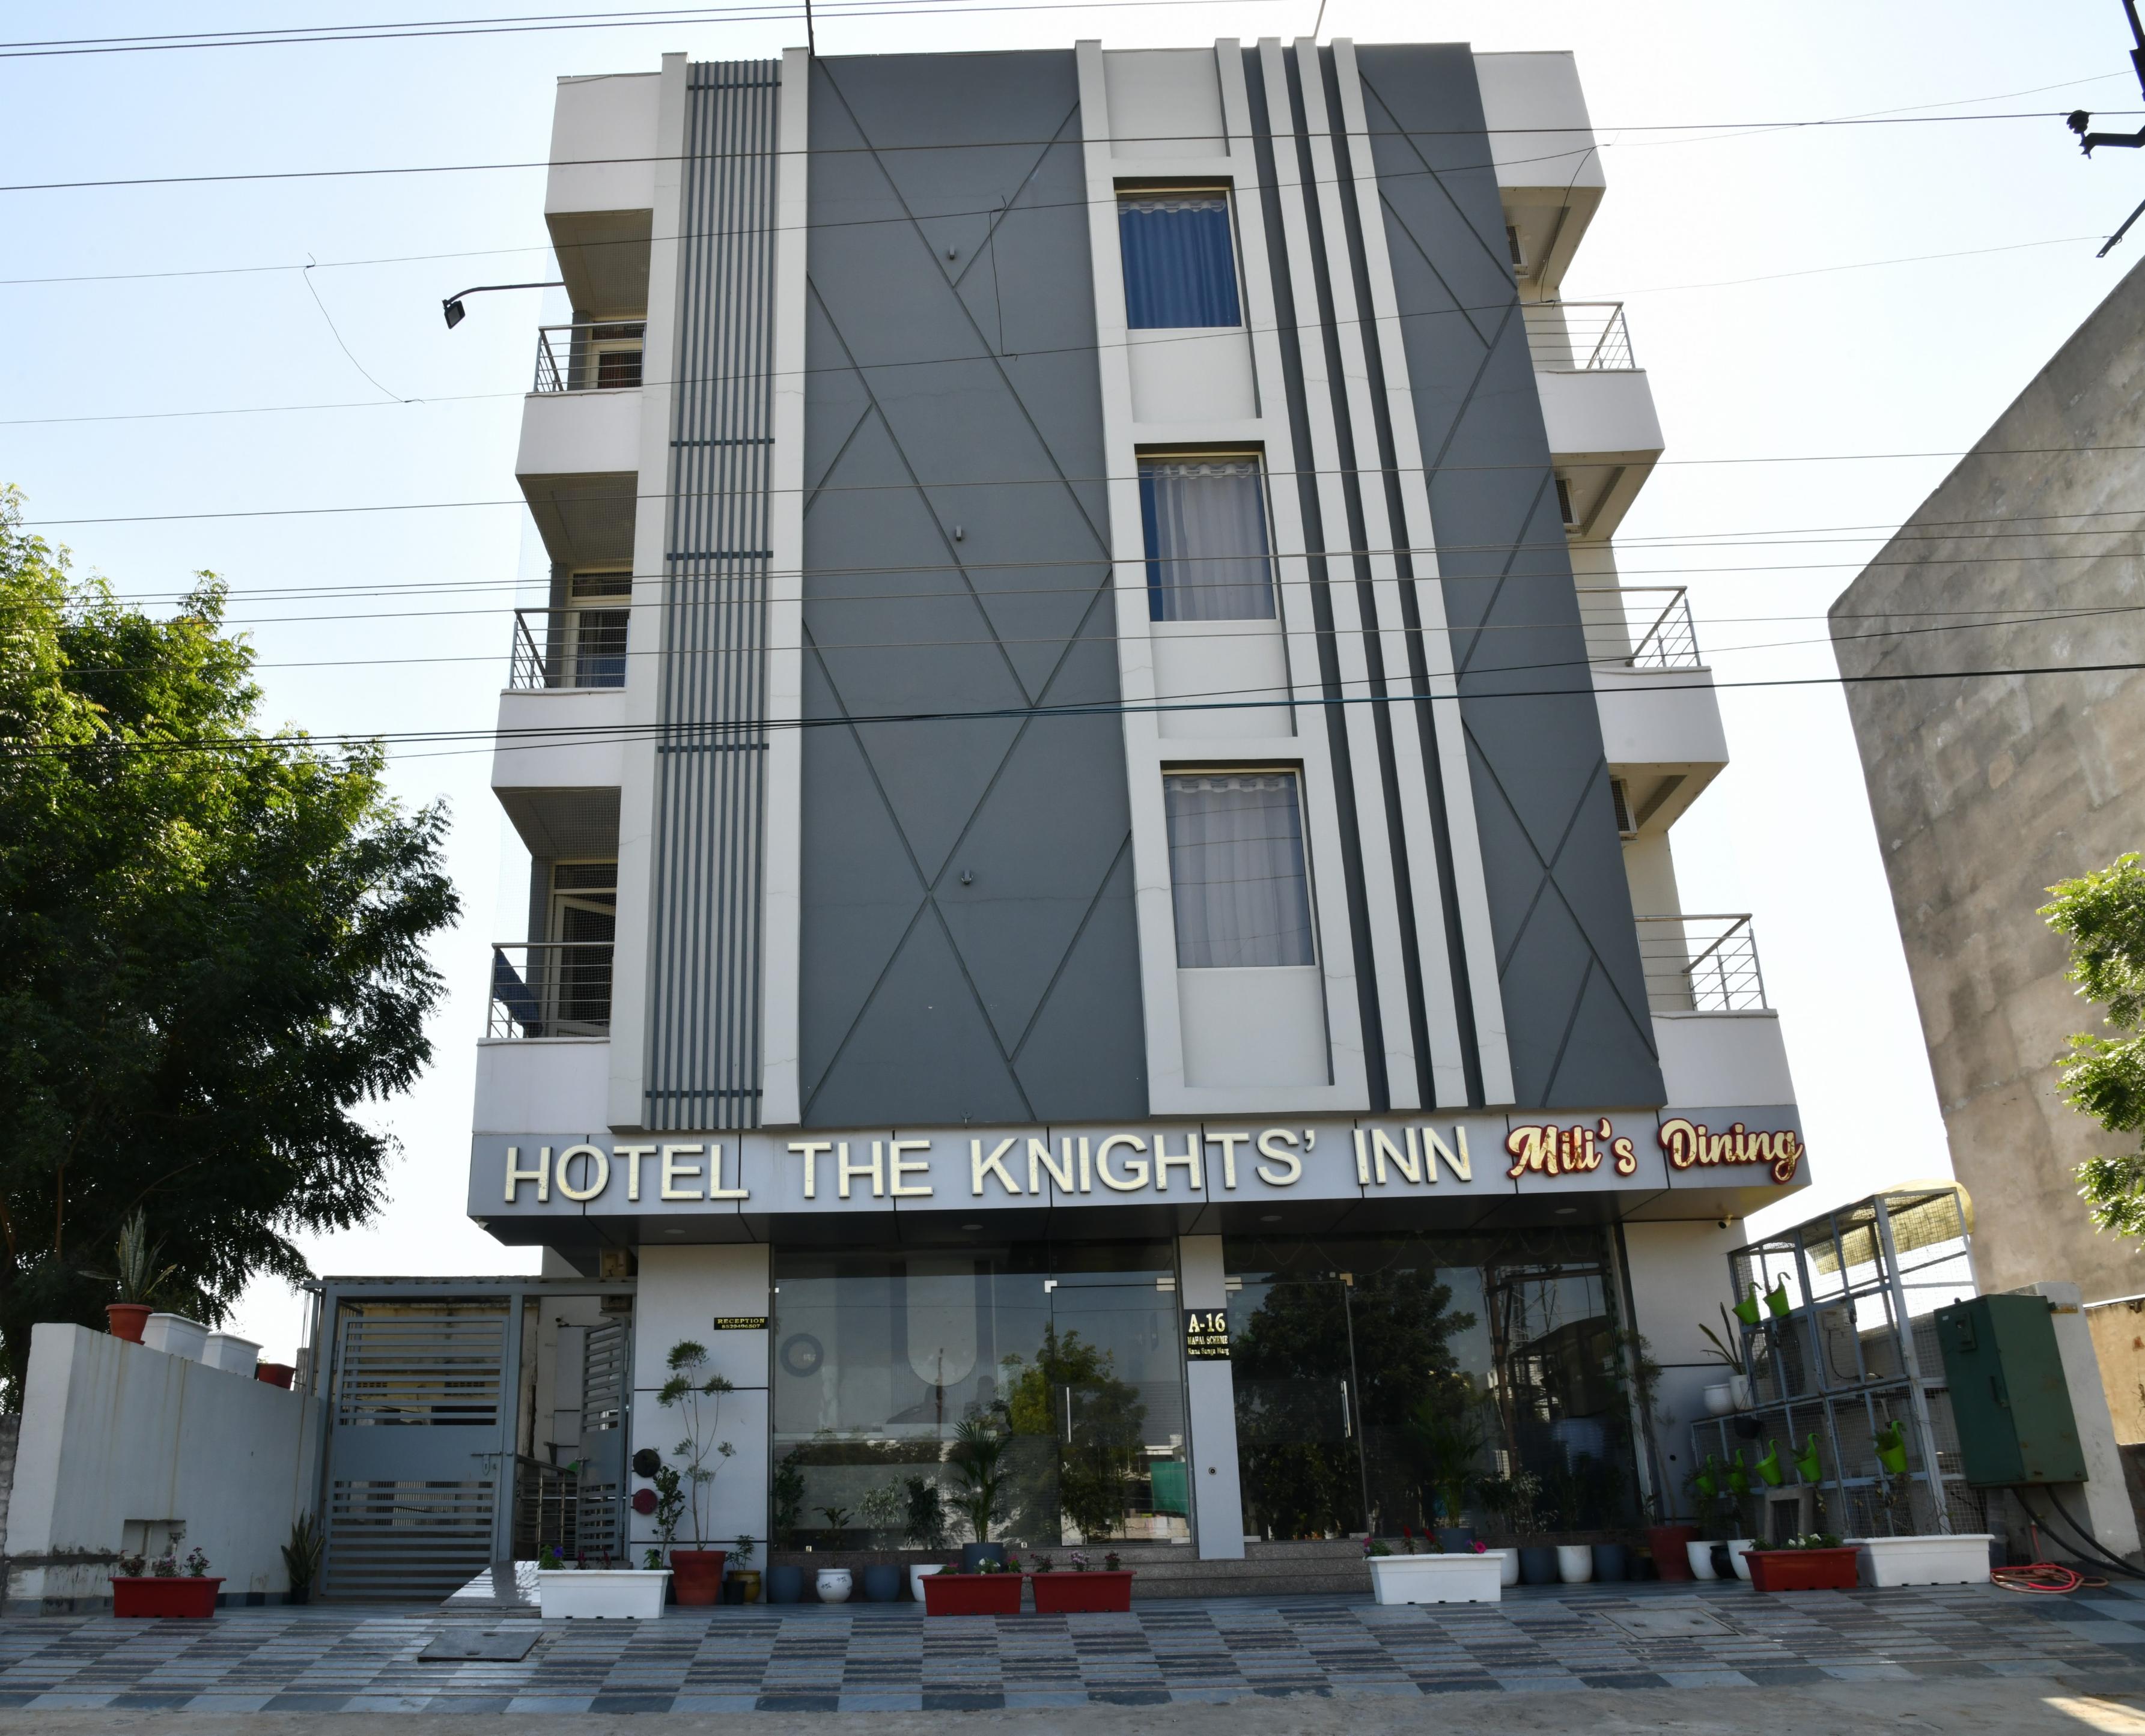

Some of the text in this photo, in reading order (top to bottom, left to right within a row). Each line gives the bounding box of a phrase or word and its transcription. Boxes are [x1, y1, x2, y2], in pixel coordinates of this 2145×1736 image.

[504, 1145, 749, 1202] HOTEL
[787, 1140, 933, 1198] THE
[1353, 1126, 1471, 1185] INN
[1659, 1118, 1804, 1185] Dining
[1188, 1313, 1226, 1333] A-16
[1206, 1335, 1228, 1344] SCHEME
